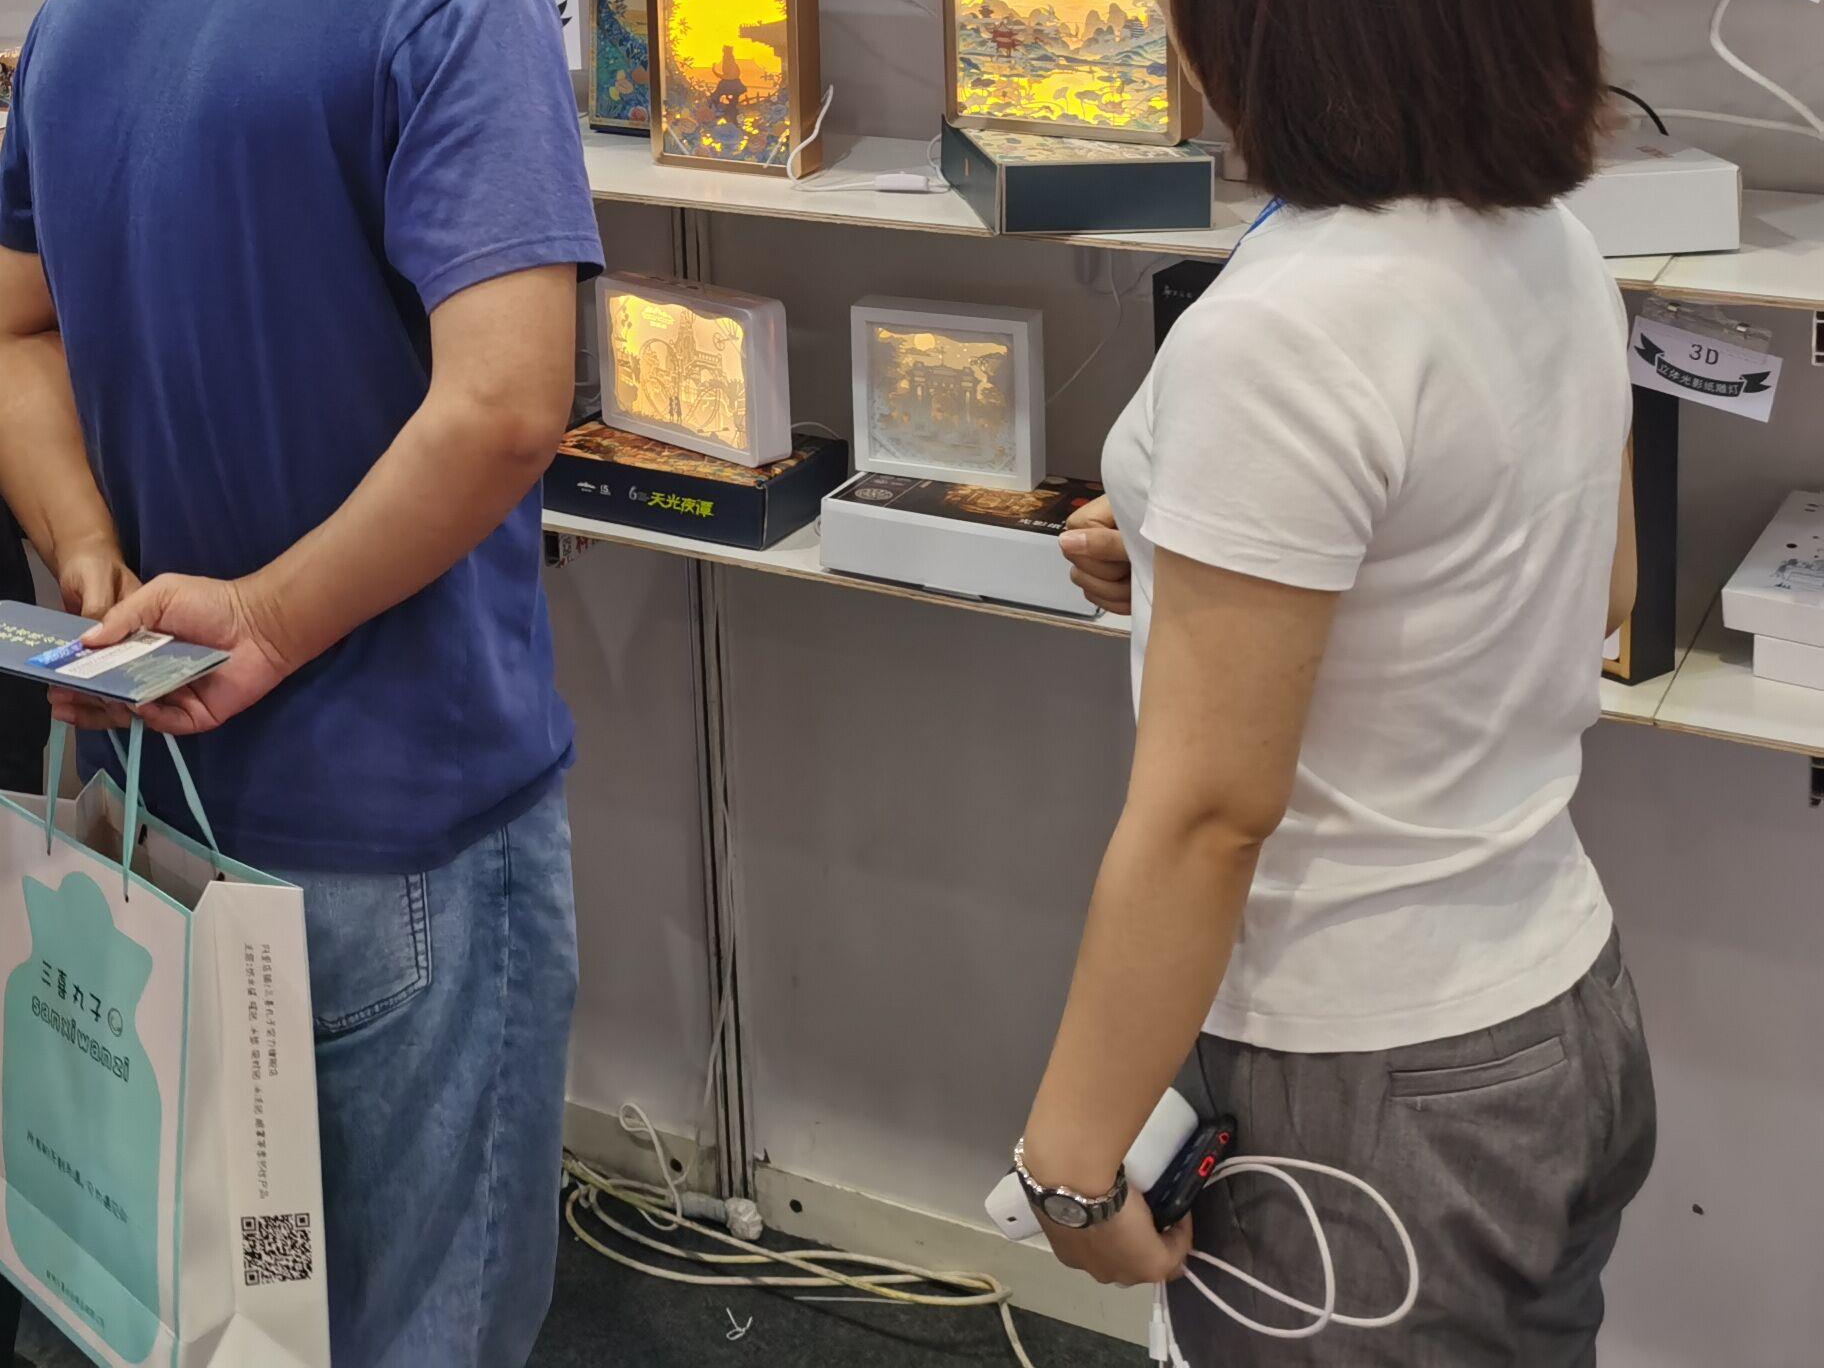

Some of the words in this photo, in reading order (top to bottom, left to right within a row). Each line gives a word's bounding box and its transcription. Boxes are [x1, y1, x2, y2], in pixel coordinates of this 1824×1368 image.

[1689, 344, 1718, 365] 3D
[41, 960, 101, 1022] 三喜丸子
